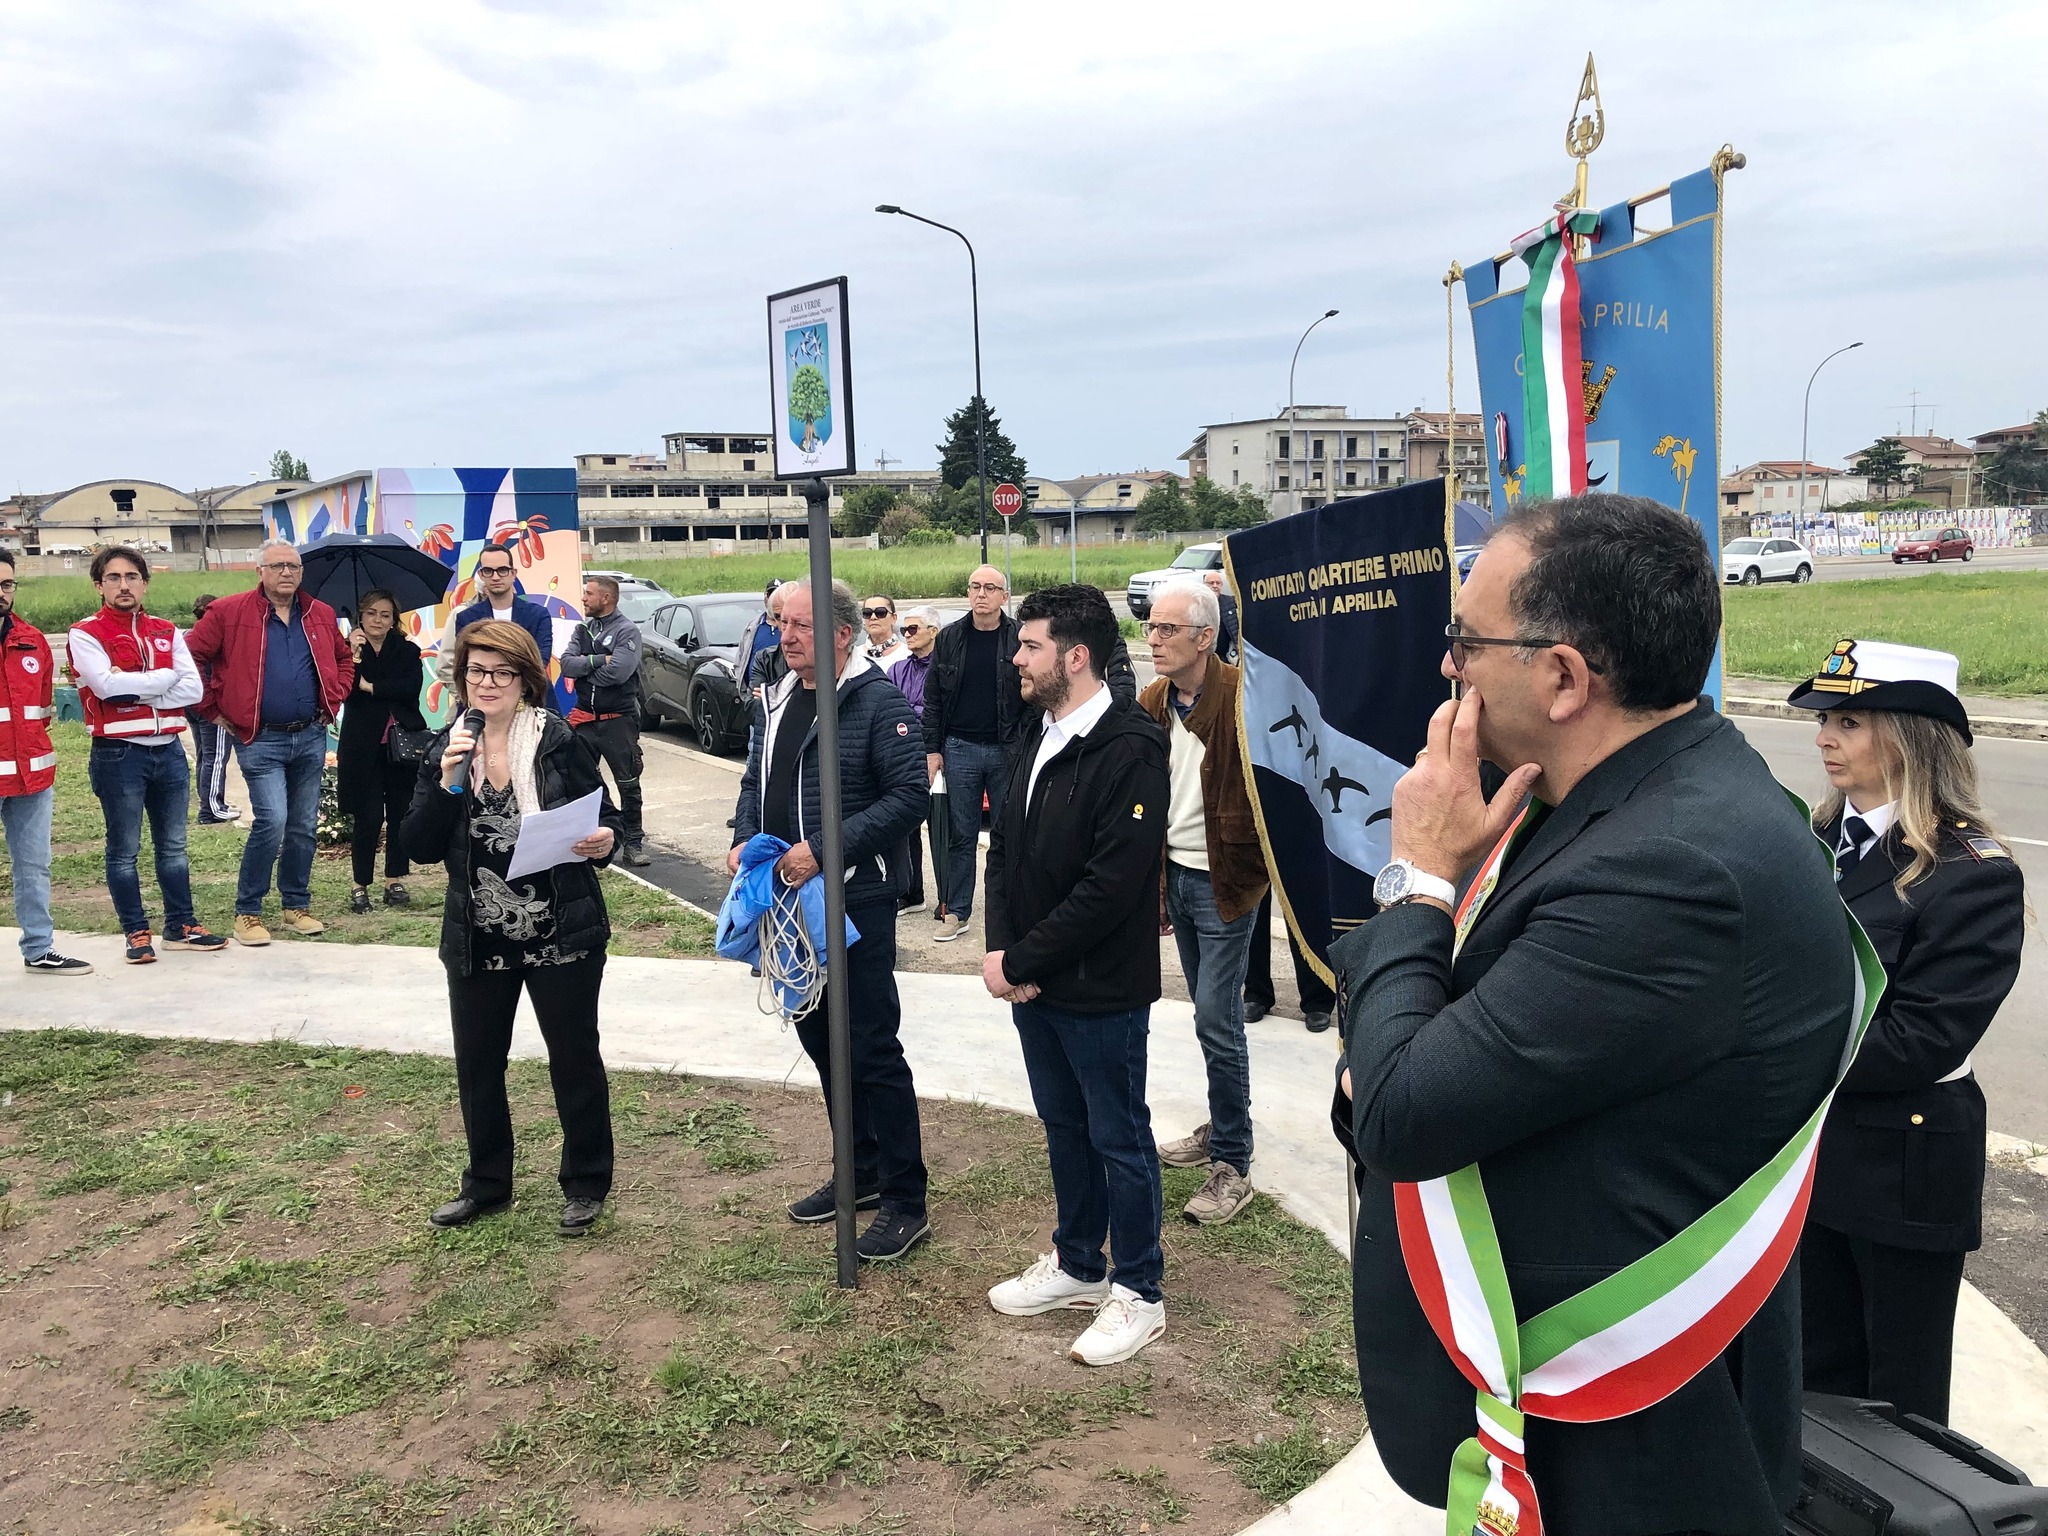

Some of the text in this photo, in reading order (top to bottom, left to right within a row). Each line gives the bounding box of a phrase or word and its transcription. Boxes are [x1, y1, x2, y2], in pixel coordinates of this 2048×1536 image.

[790, 299, 821, 313] AREA VERDE
[994, 493, 1020, 506] STOP
[1250, 570, 1305, 602] COMITATO
[1389, 547, 1444, 577] PRIMO
[1289, 596, 1319, 622] CITTÀ
[1332, 588, 1398, 615] APRILIA
